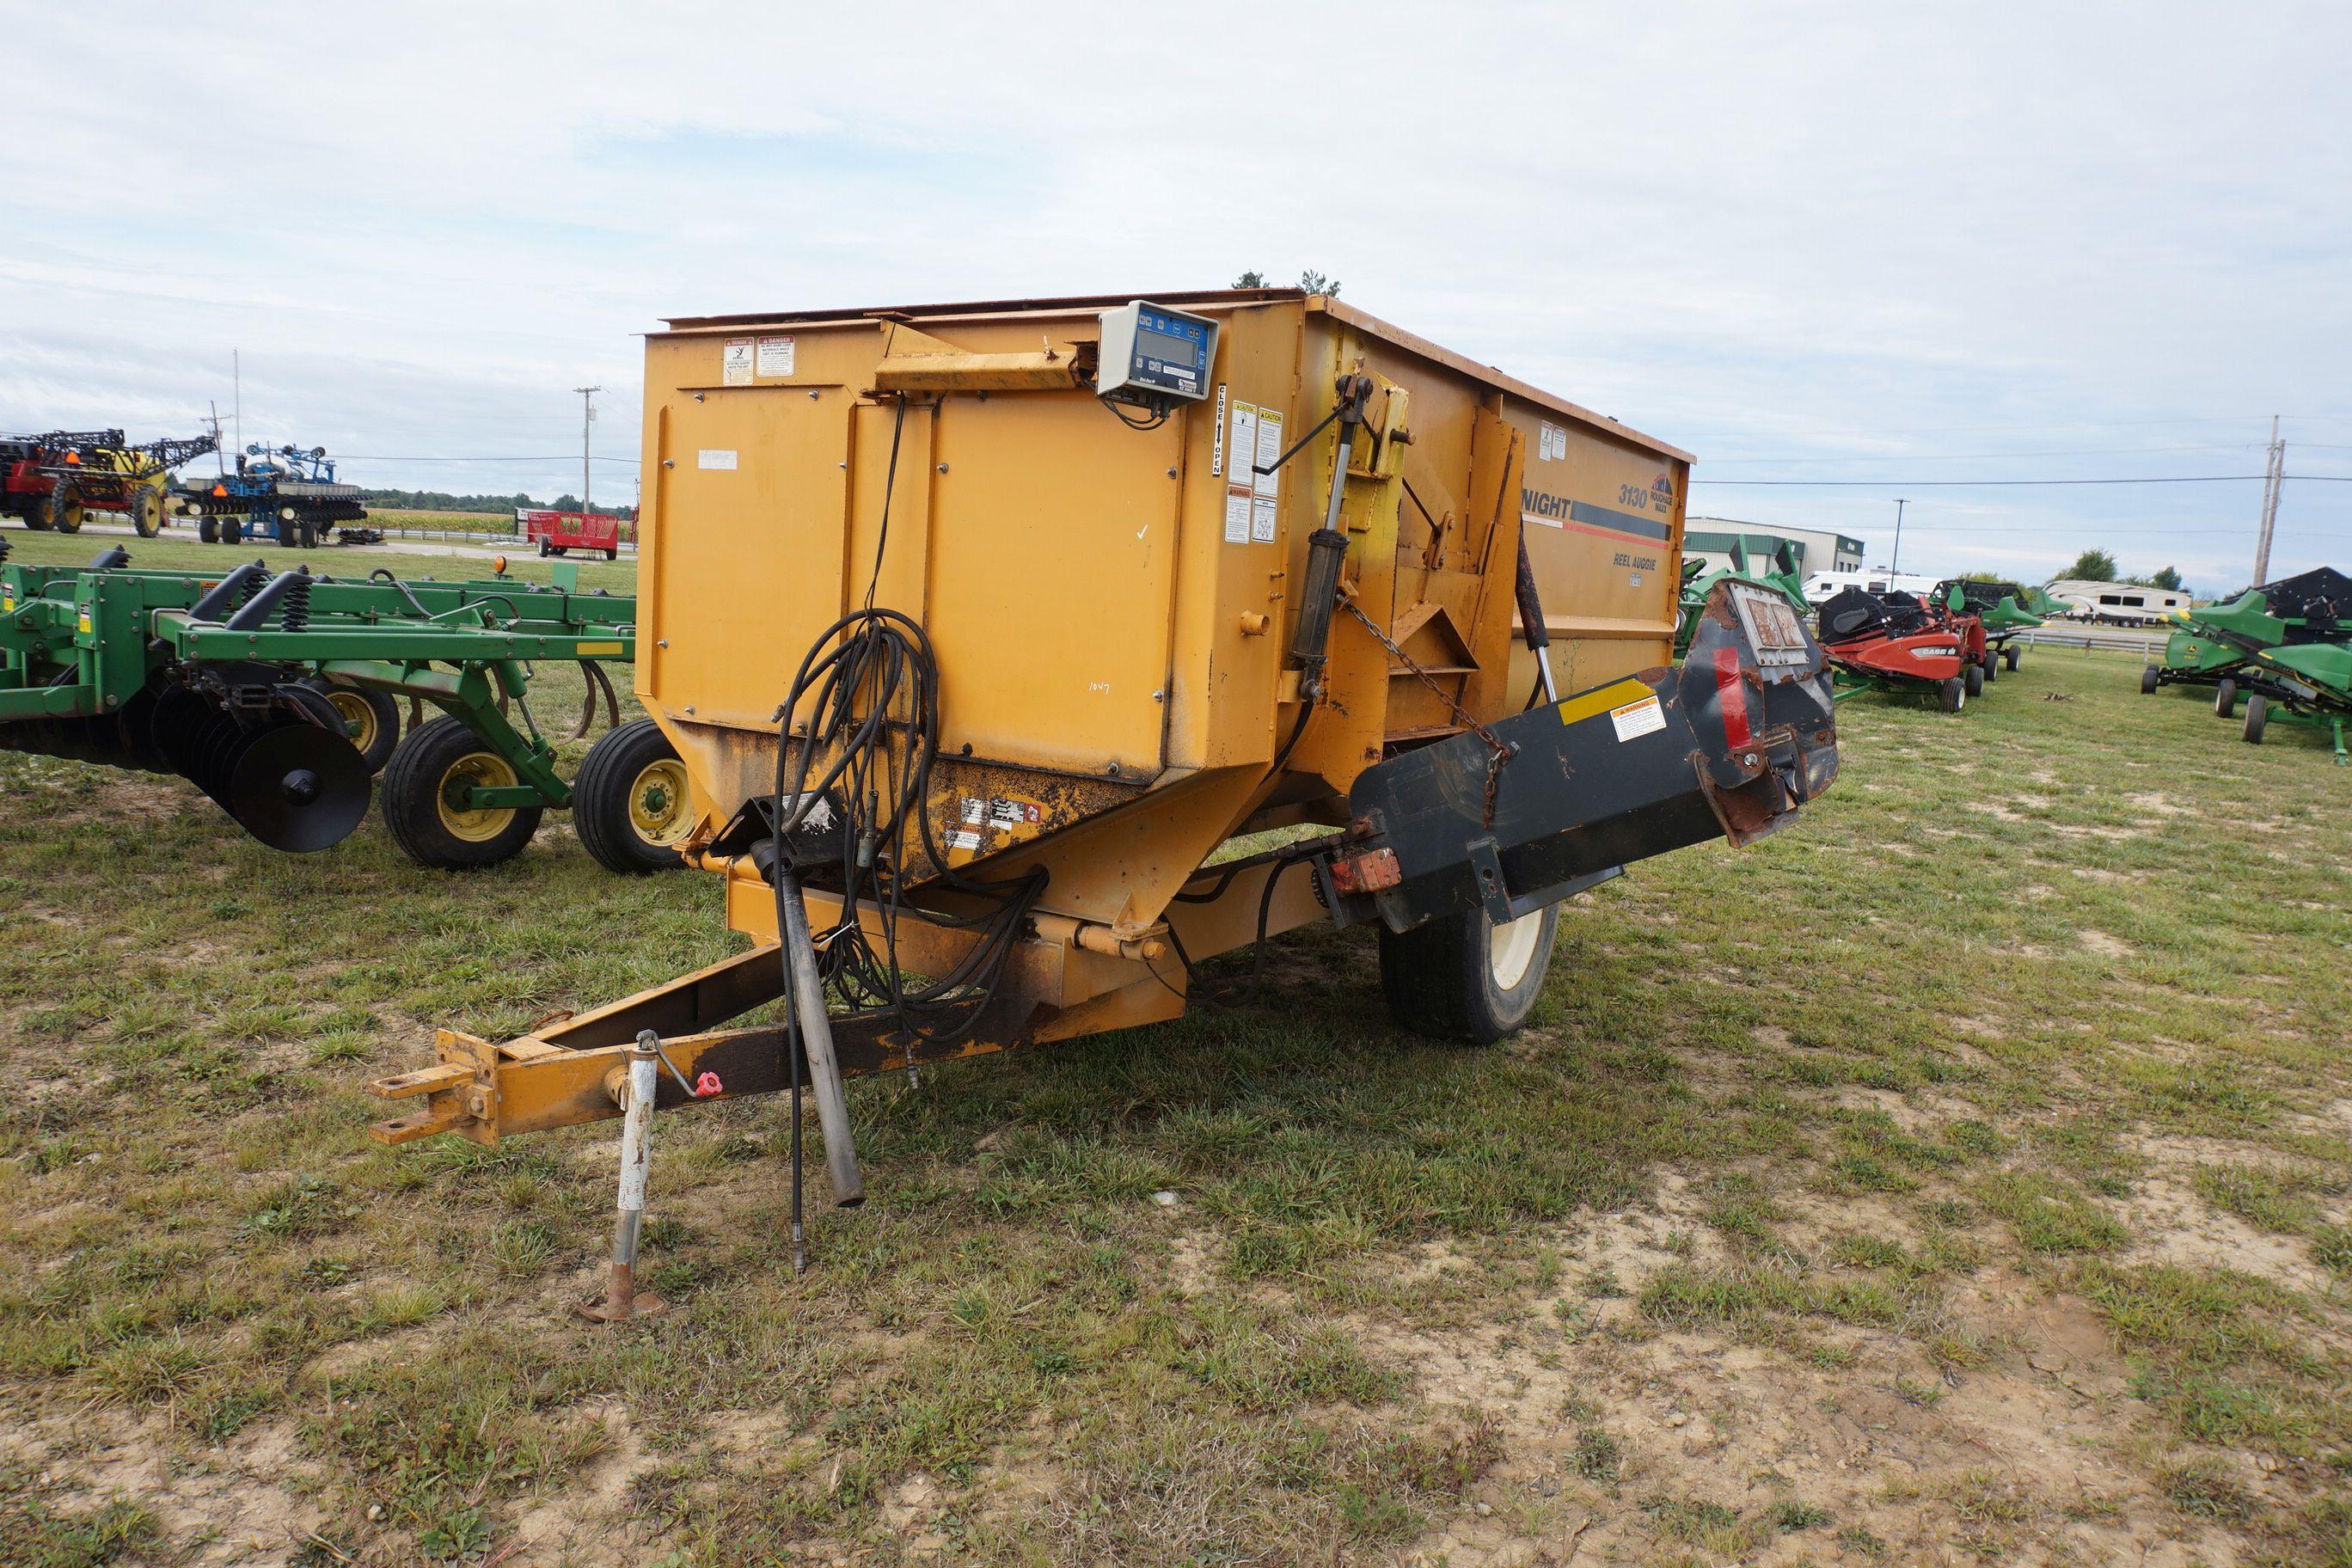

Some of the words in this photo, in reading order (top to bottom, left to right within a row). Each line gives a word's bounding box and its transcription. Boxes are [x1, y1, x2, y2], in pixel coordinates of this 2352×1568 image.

[1265, 413, 1281, 421] CAUTION
[1618, 483, 1648, 509] 3130
[1650, 491, 1672, 505] ROUGHAGE
[1521, 488, 1571, 518] NIGHT
[1656, 502, 1667, 513] MAXX
[1614, 553, 1630, 567] REEL
[1632, 556, 1656, 570] AUGGIE
[1089, 682, 1109, 694] 1047
[1626, 701, 1649, 712] WARNING
